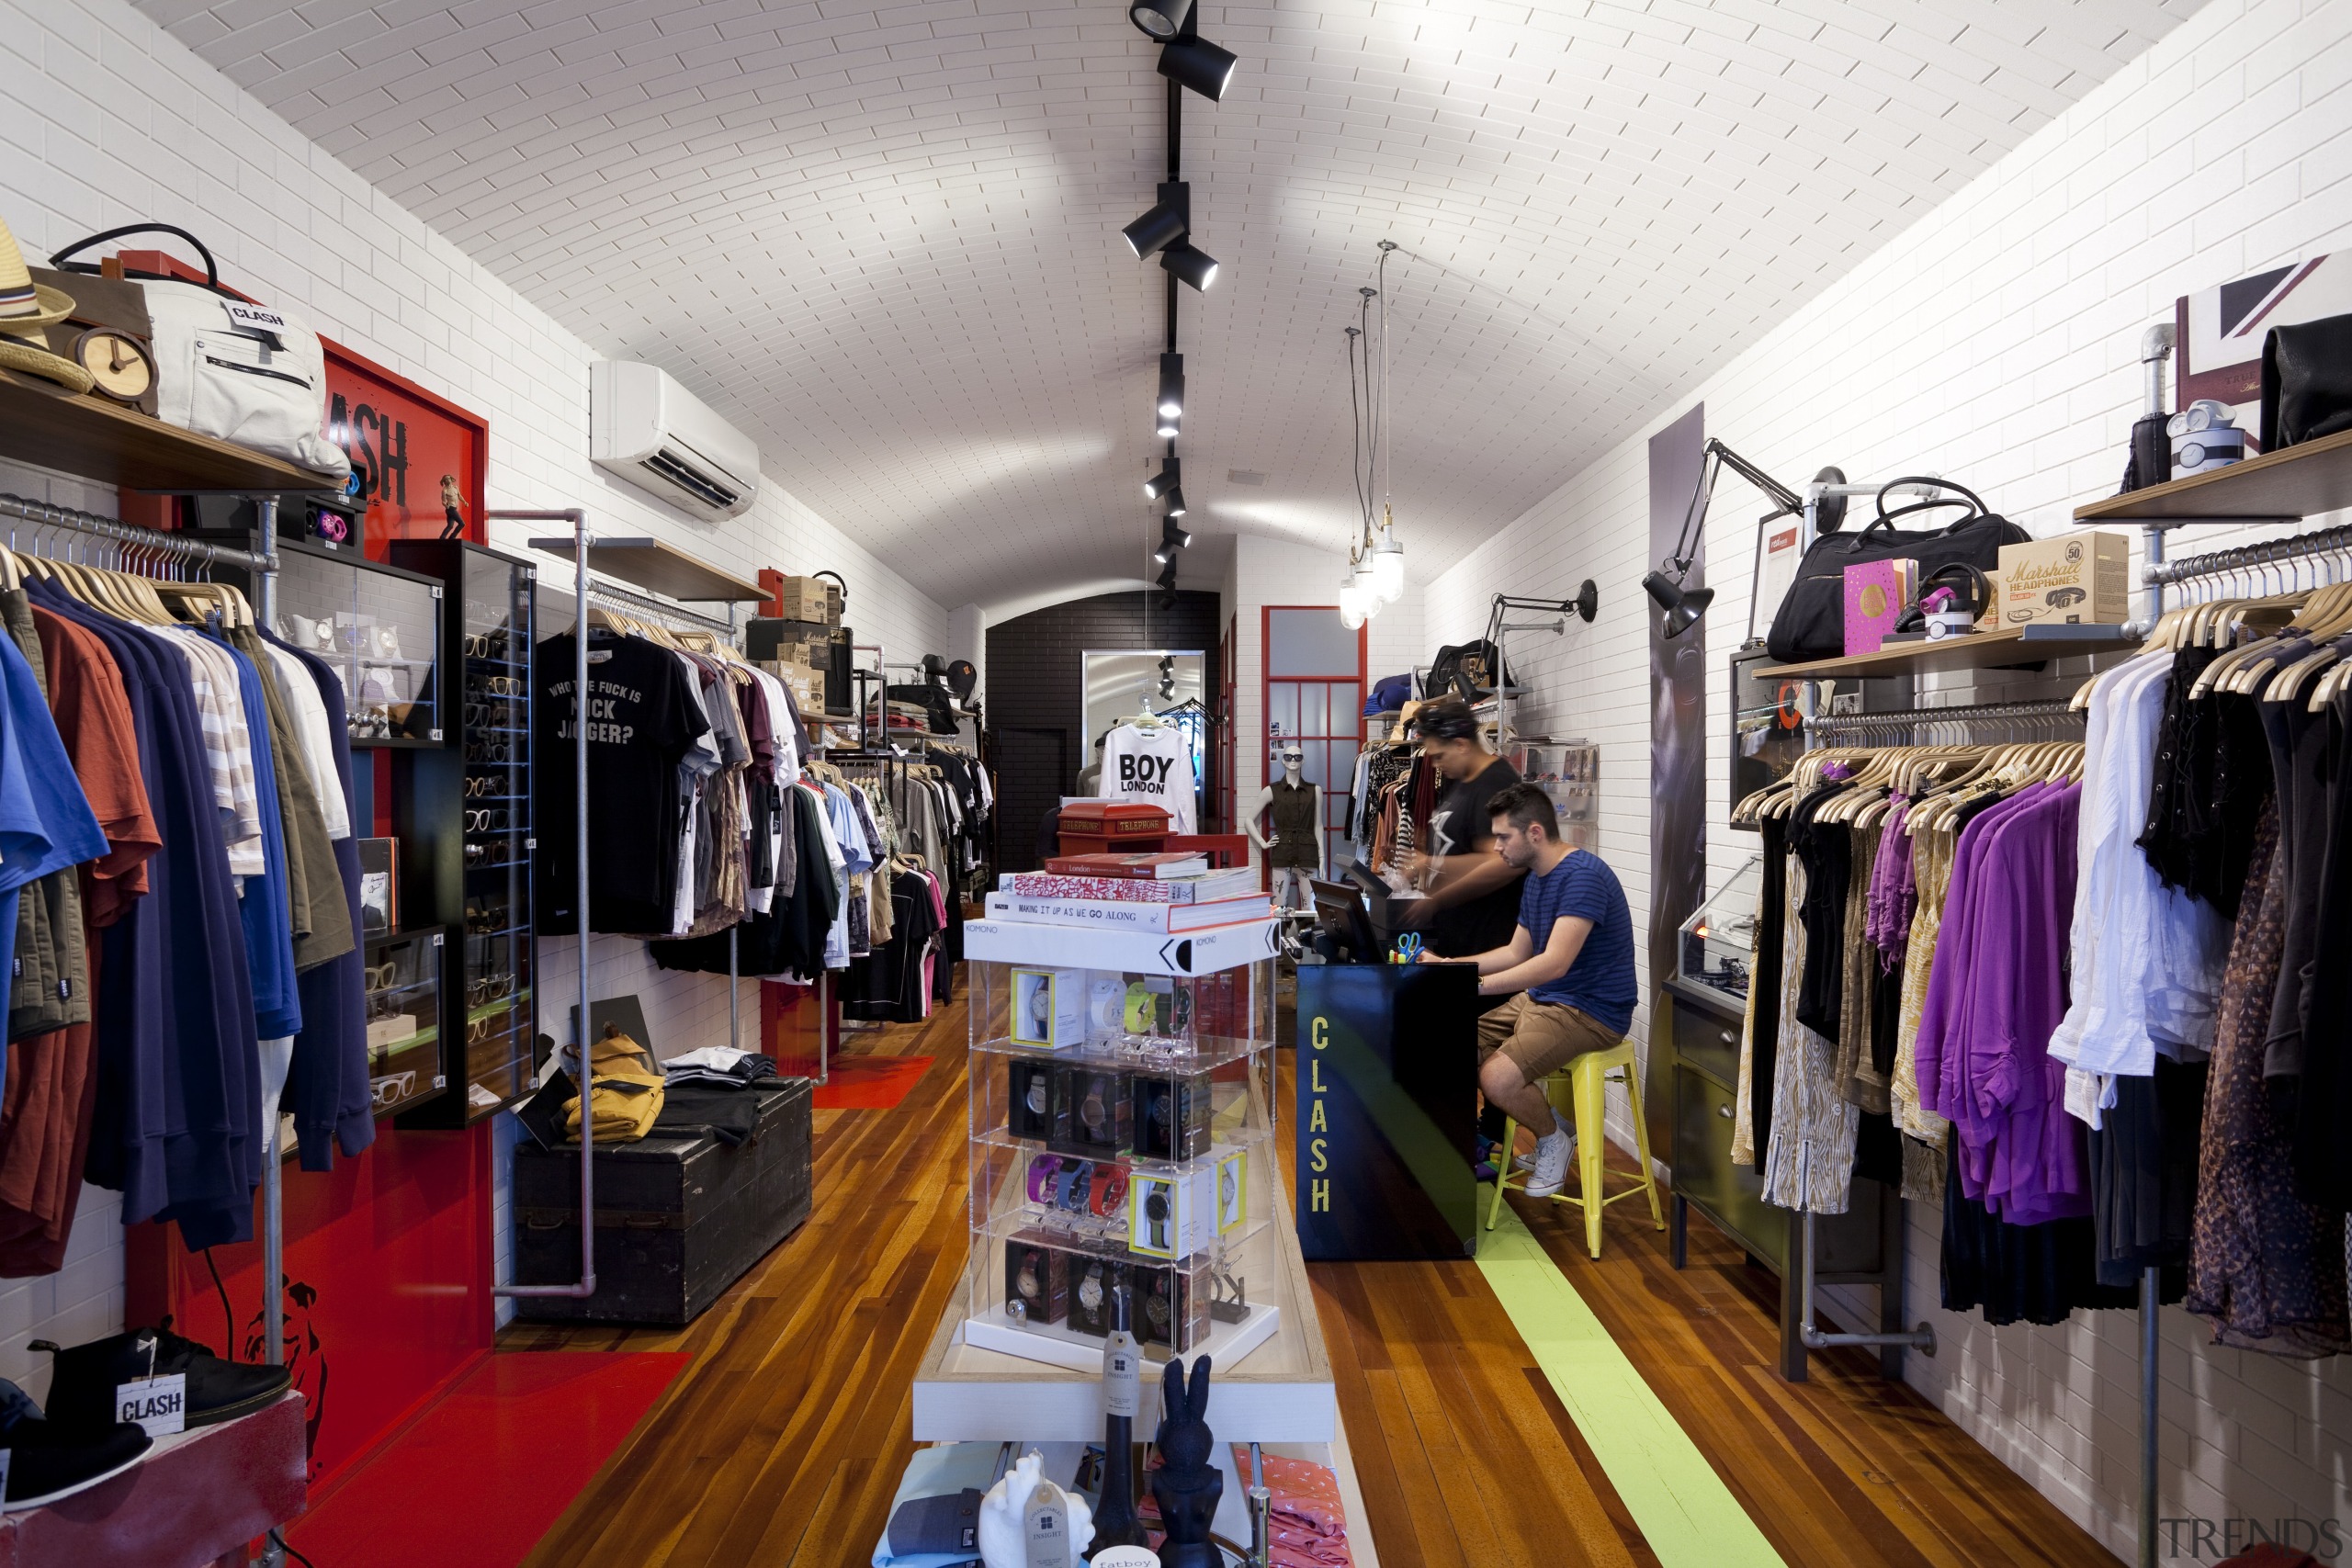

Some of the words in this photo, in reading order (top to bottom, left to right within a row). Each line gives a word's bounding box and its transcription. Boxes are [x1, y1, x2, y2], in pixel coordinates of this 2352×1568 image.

[232, 308, 284, 326] CLASH
[2068, 548, 2080, 558] 50
[2006, 557, 2085, 583] Marshall
[2009, 574, 2080, 592] HEADPHONES
[803, 631, 829, 643] Marshall
[548, 681, 571, 697] WHO
[572, 680, 594, 692] TE
[599, 681, 628, 698] FUCK
[628, 689, 641, 703] IS
[1119, 753, 1175, 784] BOY
[1121, 781, 1165, 795] LONDON
[1063, 820, 1100, 831] TELEPHONE
[1119, 819, 1159, 831] TELEPHONE
[1069, 864, 1091, 873] London
[1018, 904, 1038, 914] MAKING
[1040, 906, 1050, 915] IT
[1052, 907, 1061, 916] UP
[1063, 908, 1074, 917] AS
[1076, 908, 1087, 918] WE
[1089, 909, 1102, 919] GO
[1105, 911, 1136, 921] ALONG
[966, 924, 998, 934] KOMONO
[1196, 935, 1216, 946] KOMONO
[1309, 1016, 1329, 1213] CLASH
[1107, 1371, 1133, 1380] INSIGHT
[122, 1392, 182, 1422] CLASH
[1030, 1506, 1063, 1521] COLLECTABLES
[1033, 1530, 1062, 1540] INSIGHT
